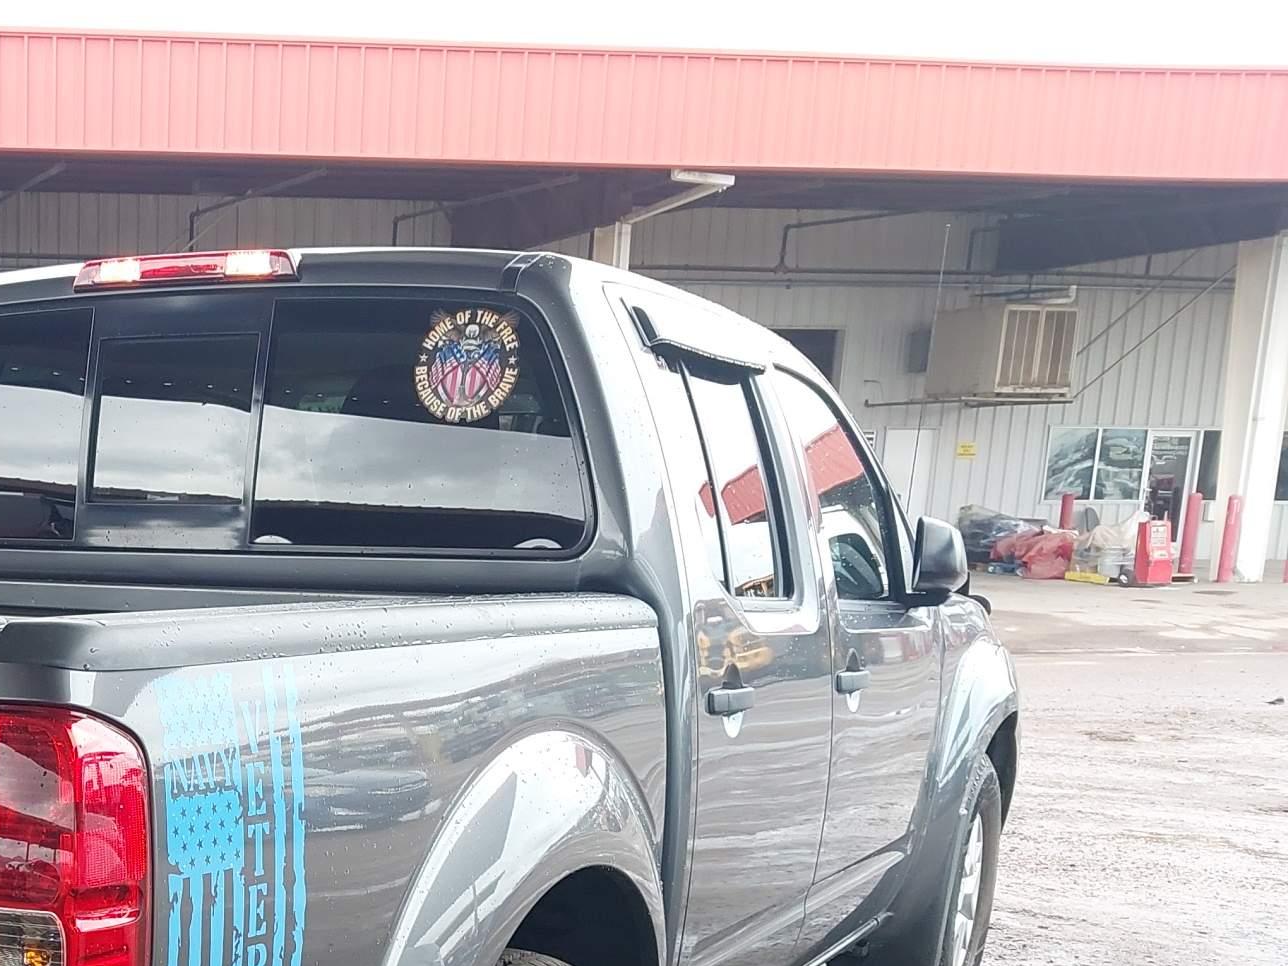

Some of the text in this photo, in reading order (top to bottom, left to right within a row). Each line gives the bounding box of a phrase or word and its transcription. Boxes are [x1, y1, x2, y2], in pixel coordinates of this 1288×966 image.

[422, 310, 519, 352] HOME OF THE FREE
[415, 366, 518, 421] BECAUSE OF THE BRAVE
[171, 743, 236, 794] NAVY
